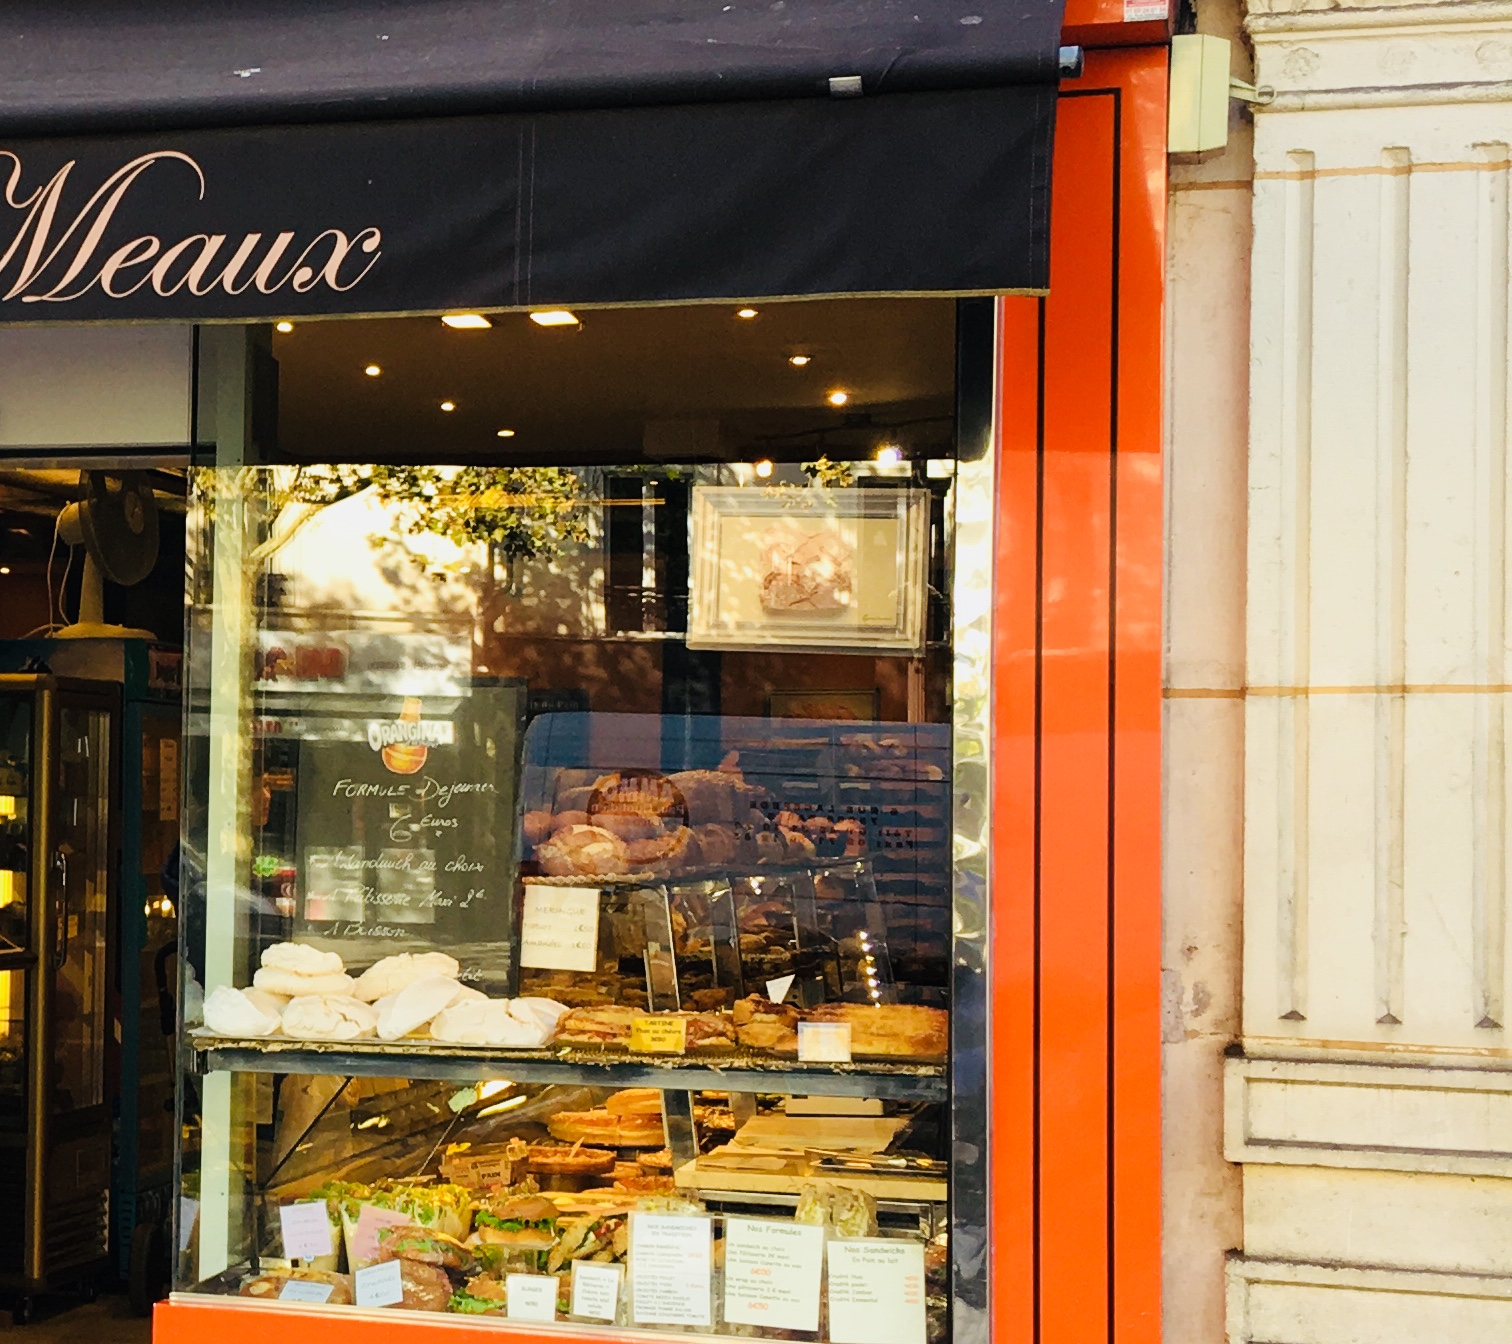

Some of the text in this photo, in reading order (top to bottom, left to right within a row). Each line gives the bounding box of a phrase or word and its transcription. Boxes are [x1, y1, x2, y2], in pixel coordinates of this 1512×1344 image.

[332, 777, 410, 798] FORMULE
[420, 813, 459, 828] Euros
[747, 1224, 802, 1236] Nos Formules
